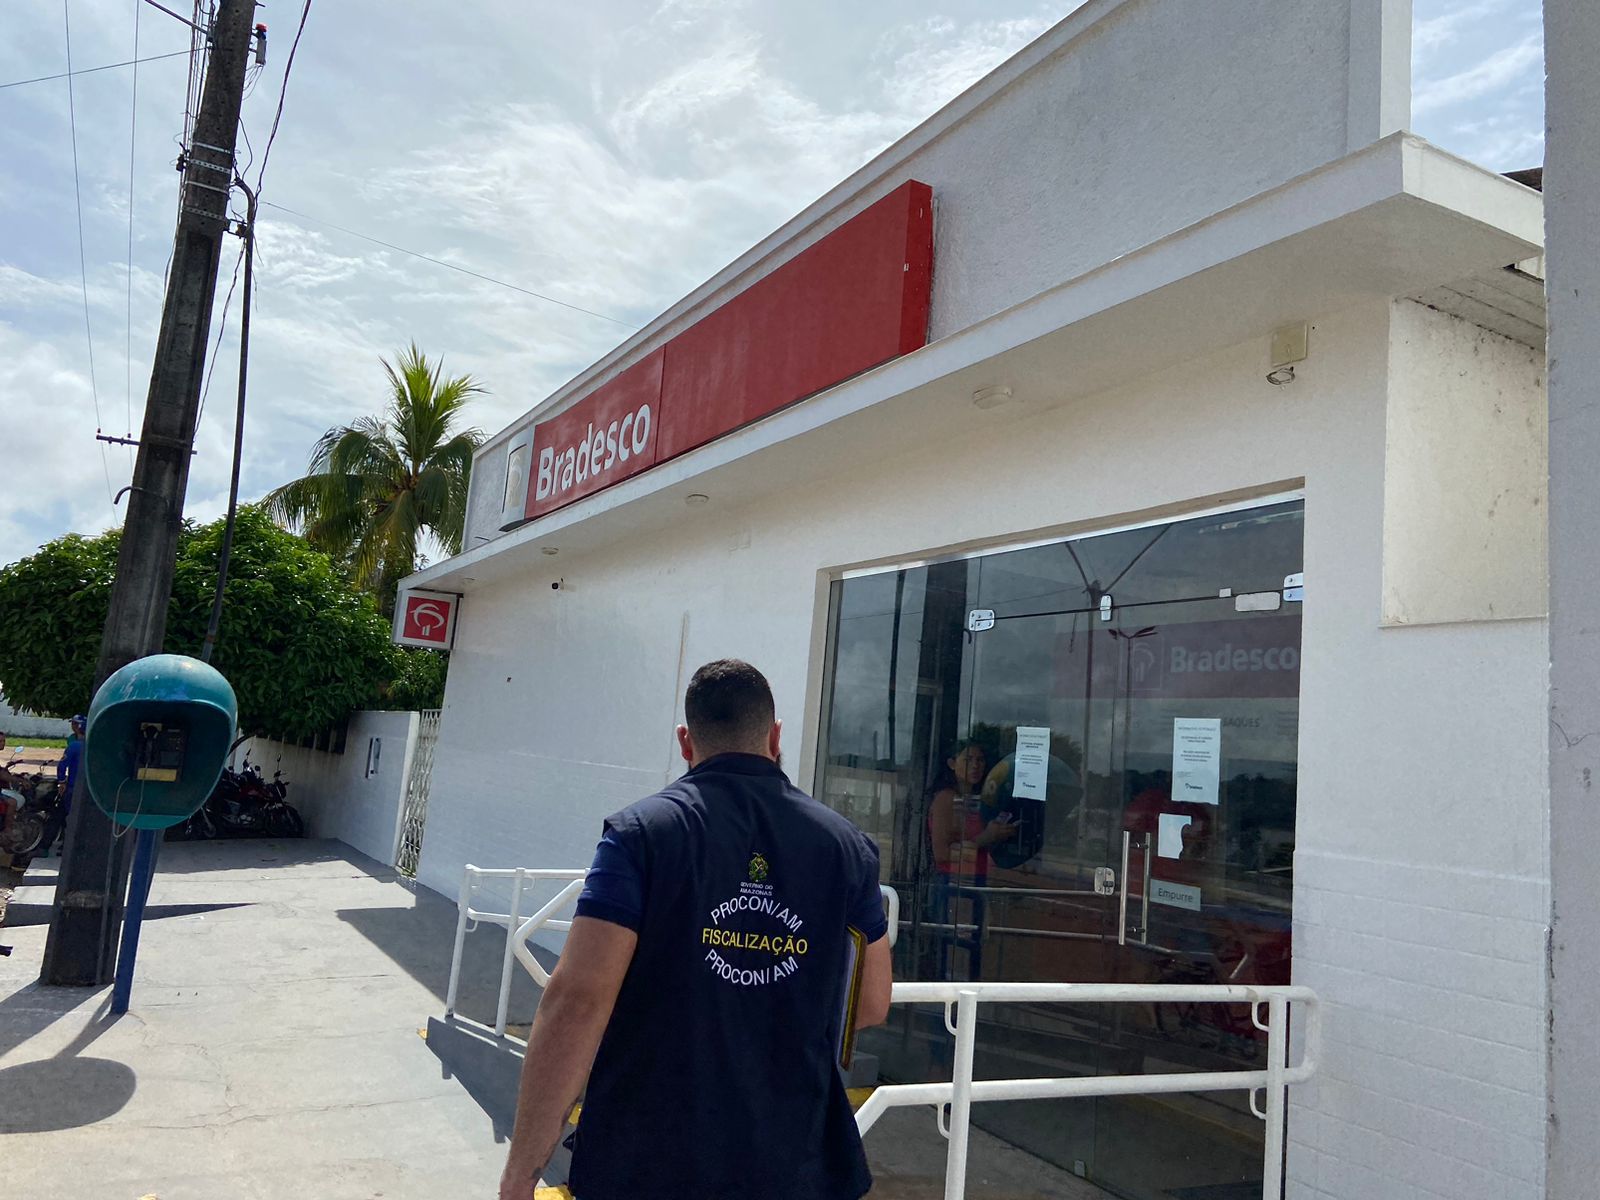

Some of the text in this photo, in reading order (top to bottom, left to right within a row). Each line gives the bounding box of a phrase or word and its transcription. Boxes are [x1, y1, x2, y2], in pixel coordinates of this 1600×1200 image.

[535, 404, 651, 501] Bradesco
[1170, 643, 1298, 673] Bradesco
[739, 887, 773, 896] AMAZONAS
[1158, 887, 1194, 903] Empurre
[710, 895, 803, 933] PROCON/AM
[702, 927, 808, 956] FISCALIZAÇÃO
